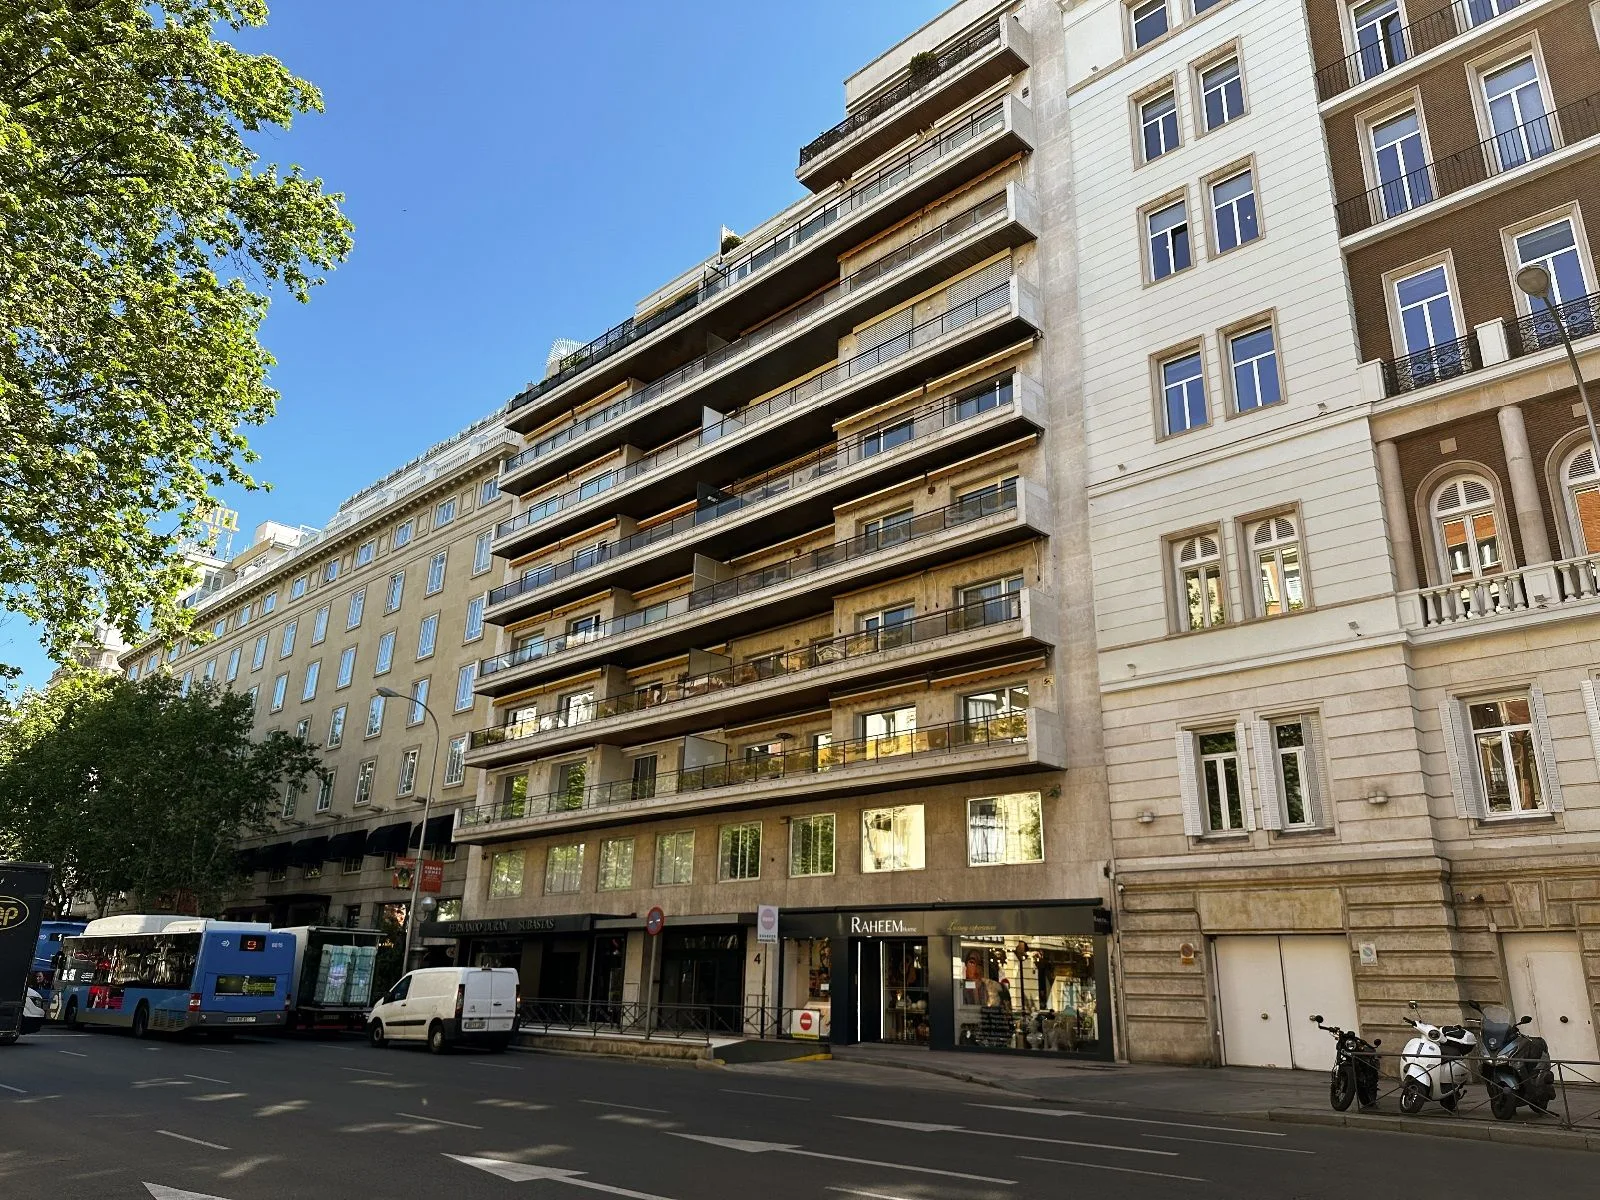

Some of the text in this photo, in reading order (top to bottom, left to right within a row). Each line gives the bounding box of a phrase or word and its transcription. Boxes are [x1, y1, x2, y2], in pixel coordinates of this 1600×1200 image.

[448, 921, 482, 933] FERNANDO
[518, 918, 555, 931] SUBASTAS
[851, 916, 903, 933] RAHEEM
[753, 952, 761, 965] 4
